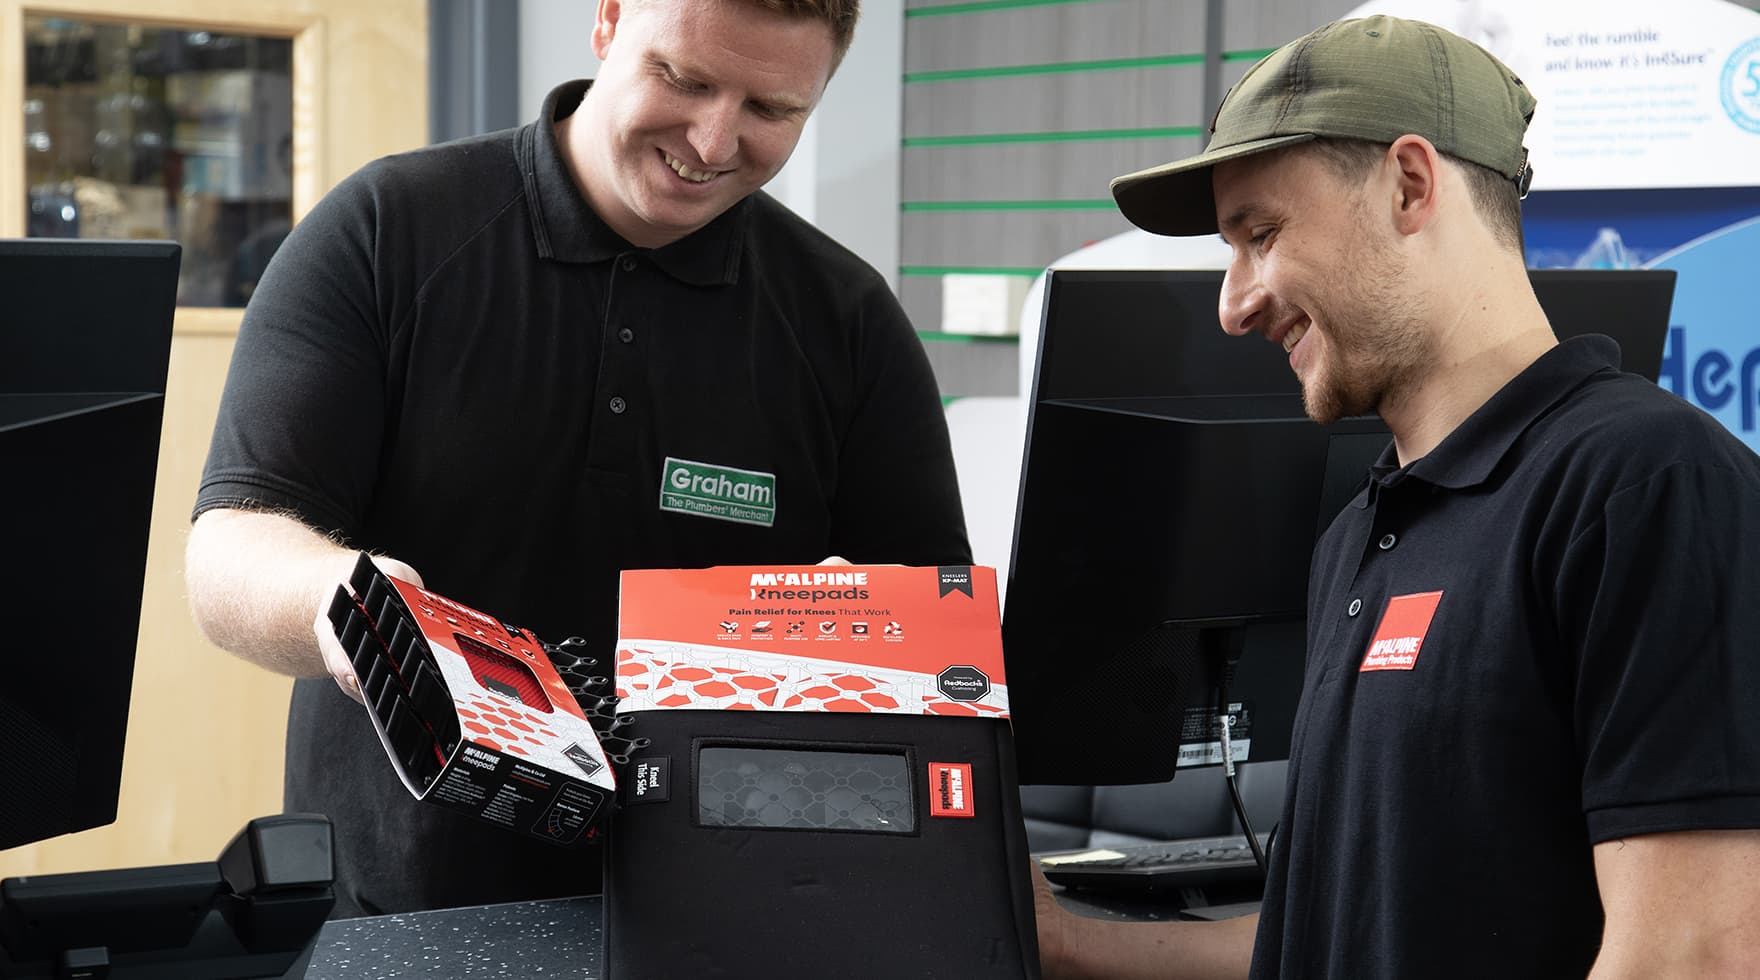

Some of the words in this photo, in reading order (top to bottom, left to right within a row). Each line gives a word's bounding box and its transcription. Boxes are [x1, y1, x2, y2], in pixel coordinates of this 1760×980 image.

[1546, 33, 1573, 48] Feel
[1577, 30, 1600, 46] the
[1606, 27, 1660, 44] rumble
[1545, 56, 1570, 72] and
[1575, 53, 1614, 70] know
[670, 467, 771, 504] Graham
[666, 496, 683, 507] The
[685, 498, 729, 514] Plumbers'
[730, 507, 769, 520] Merchant
[750, 573, 868, 586] McALPINE
[729, 608, 751, 616] Pain
[755, 608, 785, 616] Relief
[787, 608, 801, 616] for
[804, 608, 836, 616] Knees
[838, 608, 861, 616] That
[864, 608, 891, 616] Work
[638, 763, 648, 779] This
[649, 766, 660, 787] Kneel
[636, 779, 647, 796] Side
